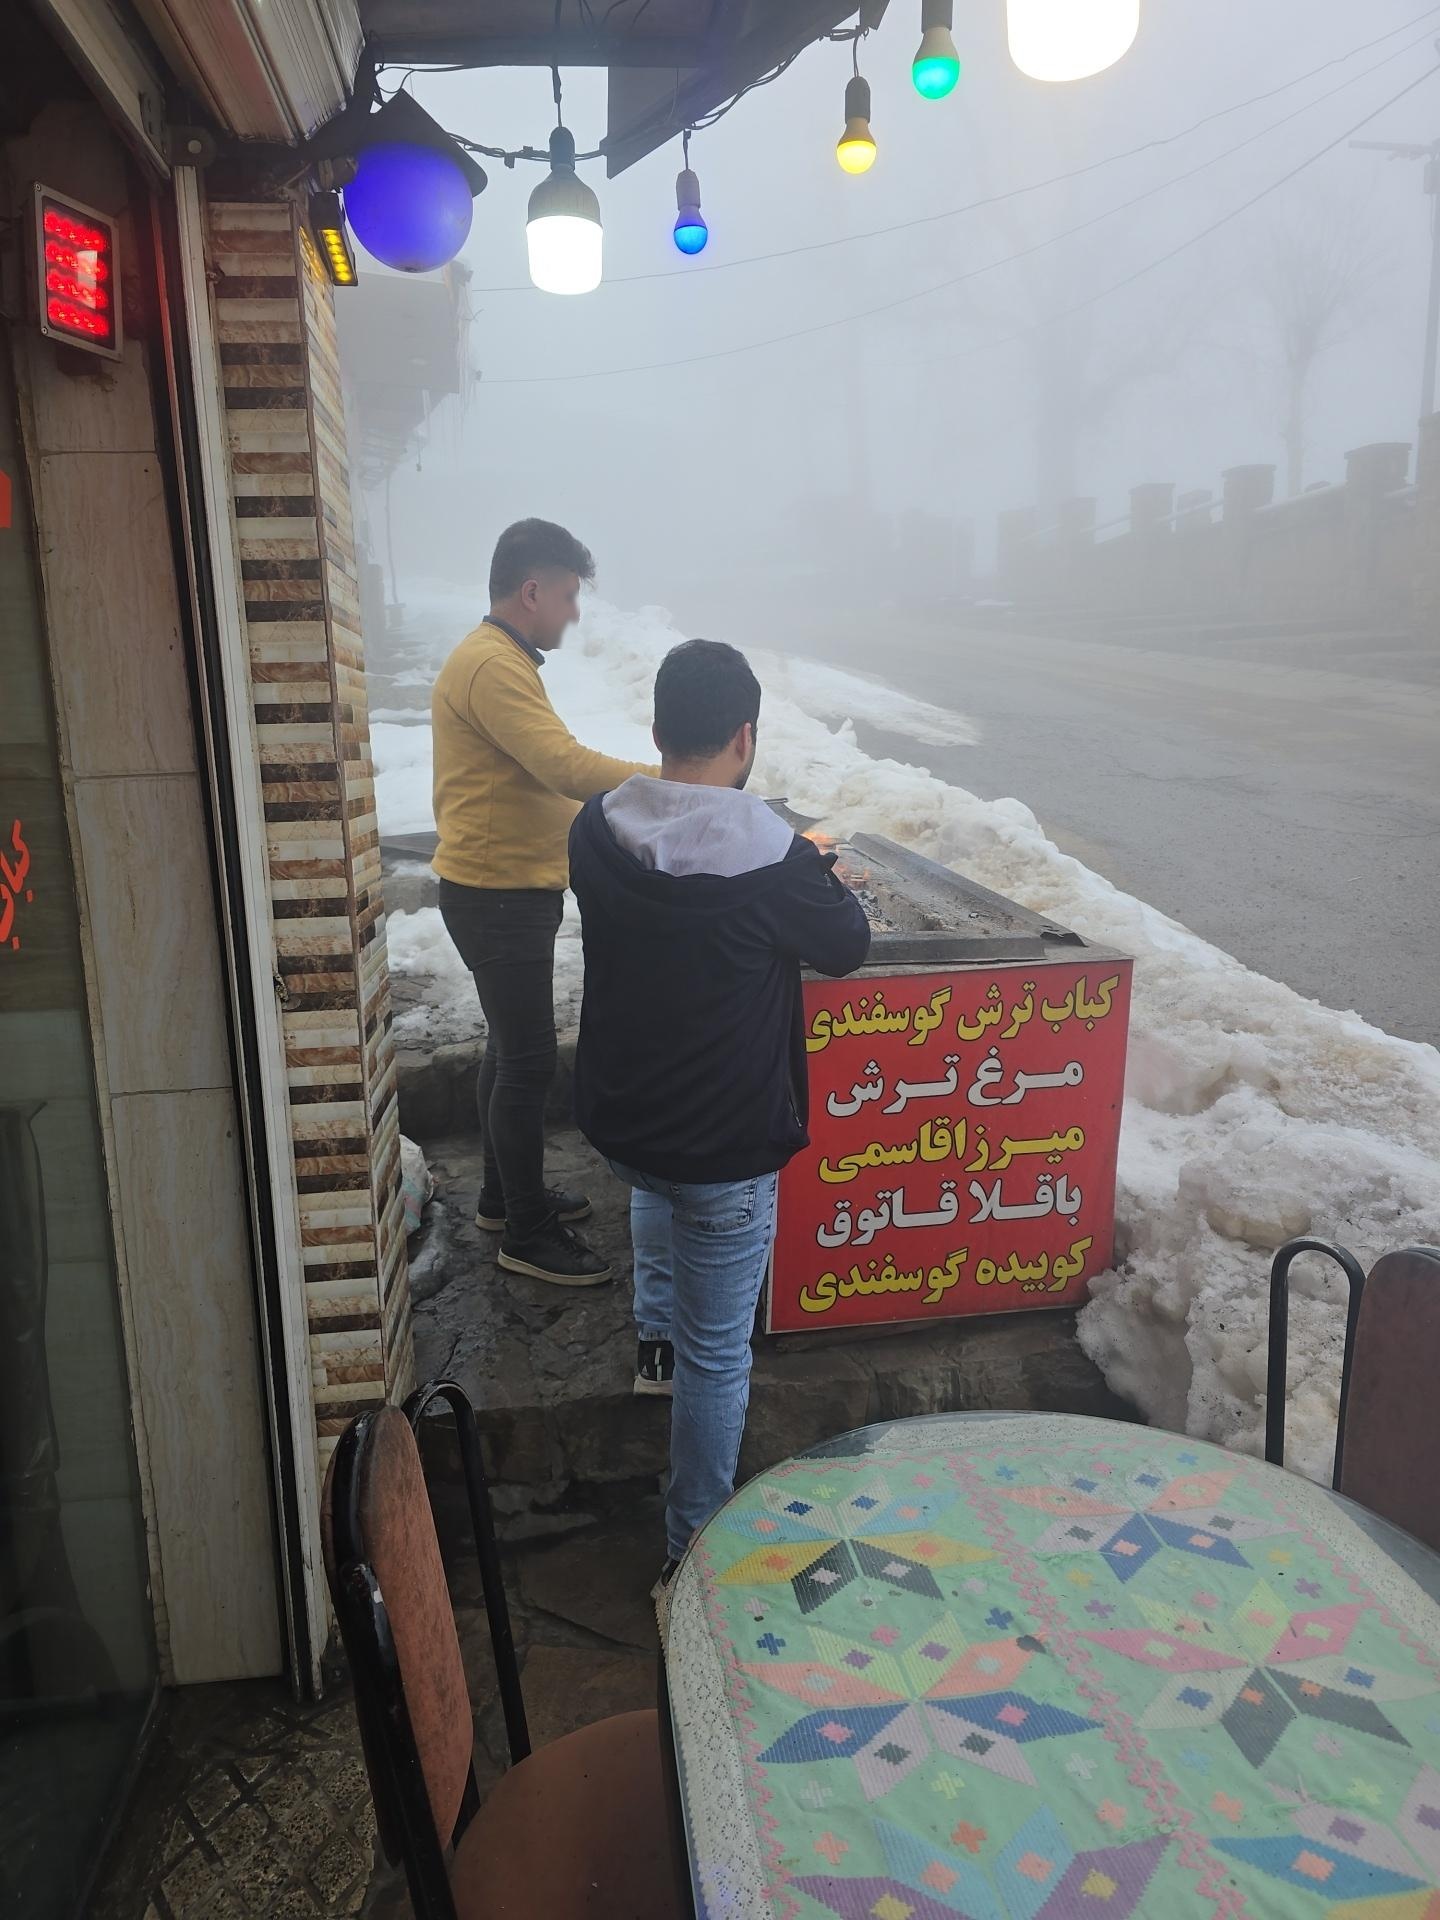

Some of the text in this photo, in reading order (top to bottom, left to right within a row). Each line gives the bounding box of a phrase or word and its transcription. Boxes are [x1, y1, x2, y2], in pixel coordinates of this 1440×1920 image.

[805, 974, 1120, 1053] کباب ترش گوسفندی
[826, 1046, 1084, 1117] مرغ ترش
[816, 1173, 1082, 1248] باقلا قاتوق
[799, 1236, 1093, 1313] کوبیده گوسفندی
